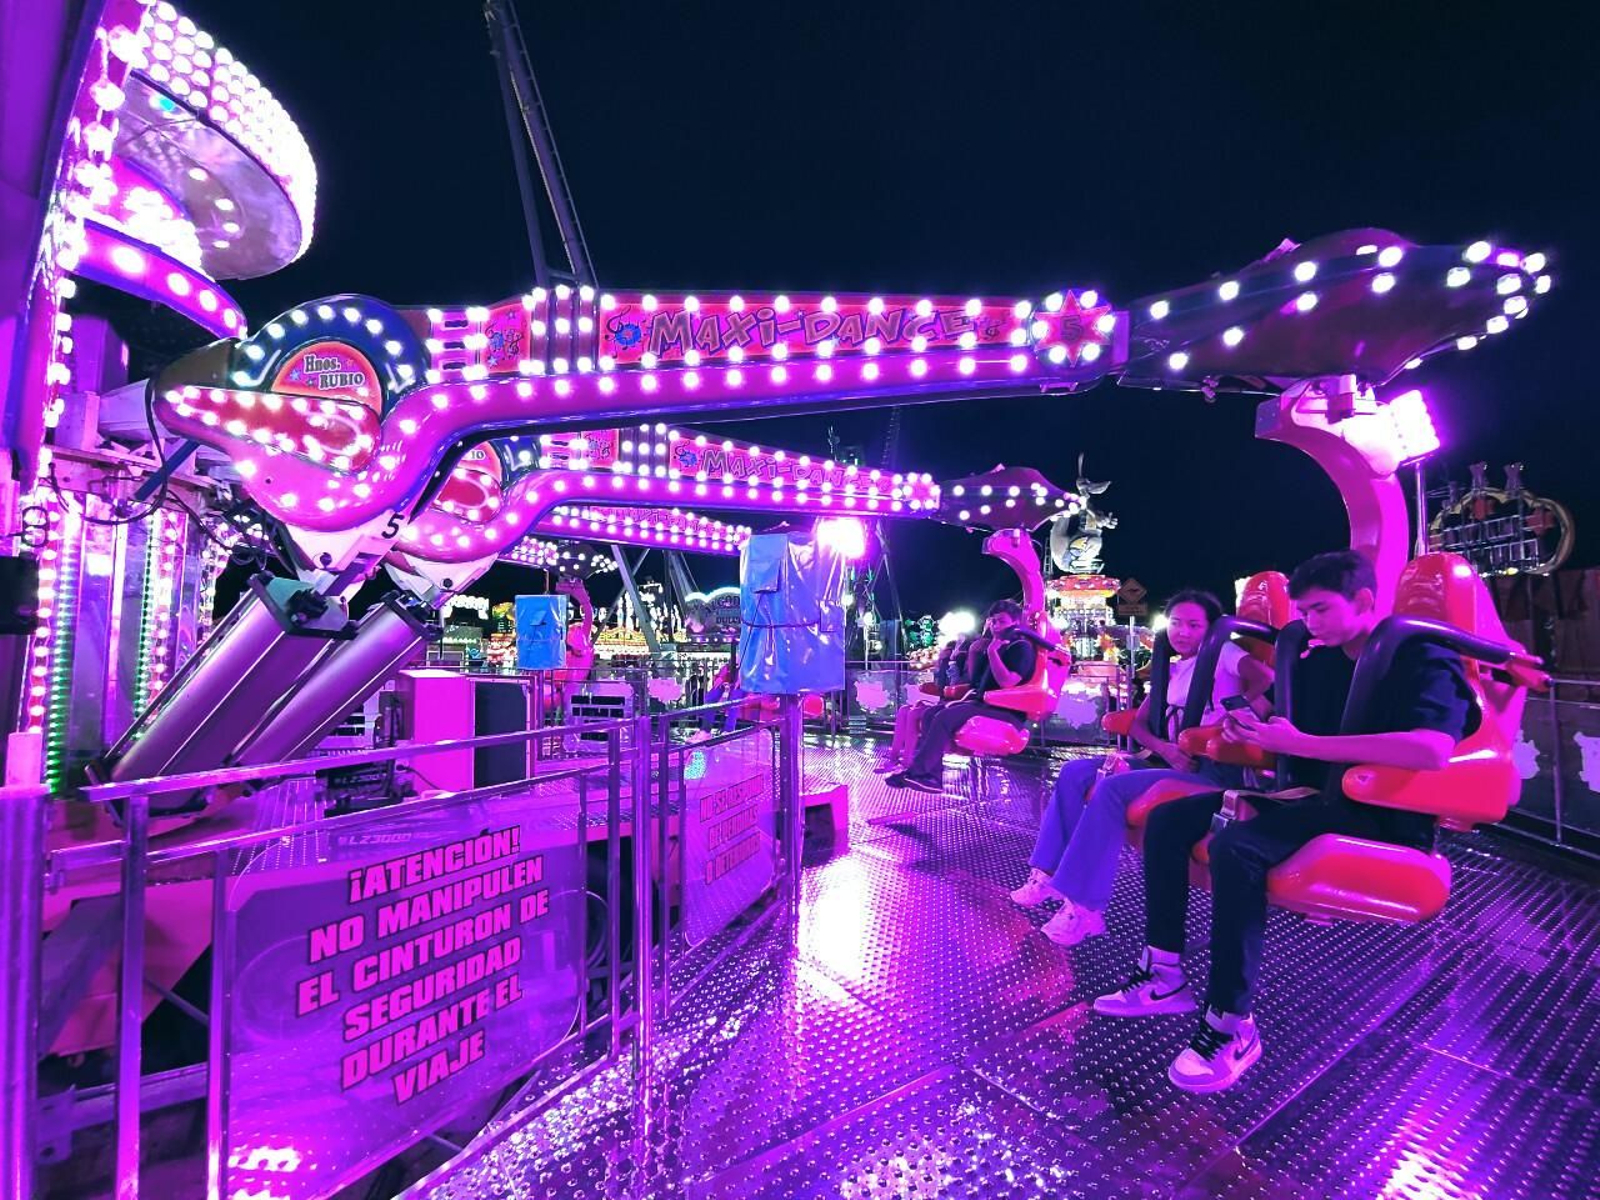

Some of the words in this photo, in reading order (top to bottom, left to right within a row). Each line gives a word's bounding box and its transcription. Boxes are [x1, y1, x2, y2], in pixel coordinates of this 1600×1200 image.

[304, 355, 340, 373] Hnos.
[1061, 315, 1084, 341] 5
[319, 372, 364, 390] RUBIO
[381, 513, 405, 539] 5
[349, 827, 521, 904] ¡ATENCIÓN!
[309, 915, 365, 965] NO
[377, 855, 544, 939] MANIPULEN
[296, 970, 340, 1018] EL
[353, 903, 511, 993] CINTURON
[519, 890, 550, 925] DE
[343, 937, 522, 1043] SEGURIDAD
[340, 988, 490, 1091] DURANTE
[494, 973, 523, 1011] EL
[392, 1029, 486, 1106] VIAJE
